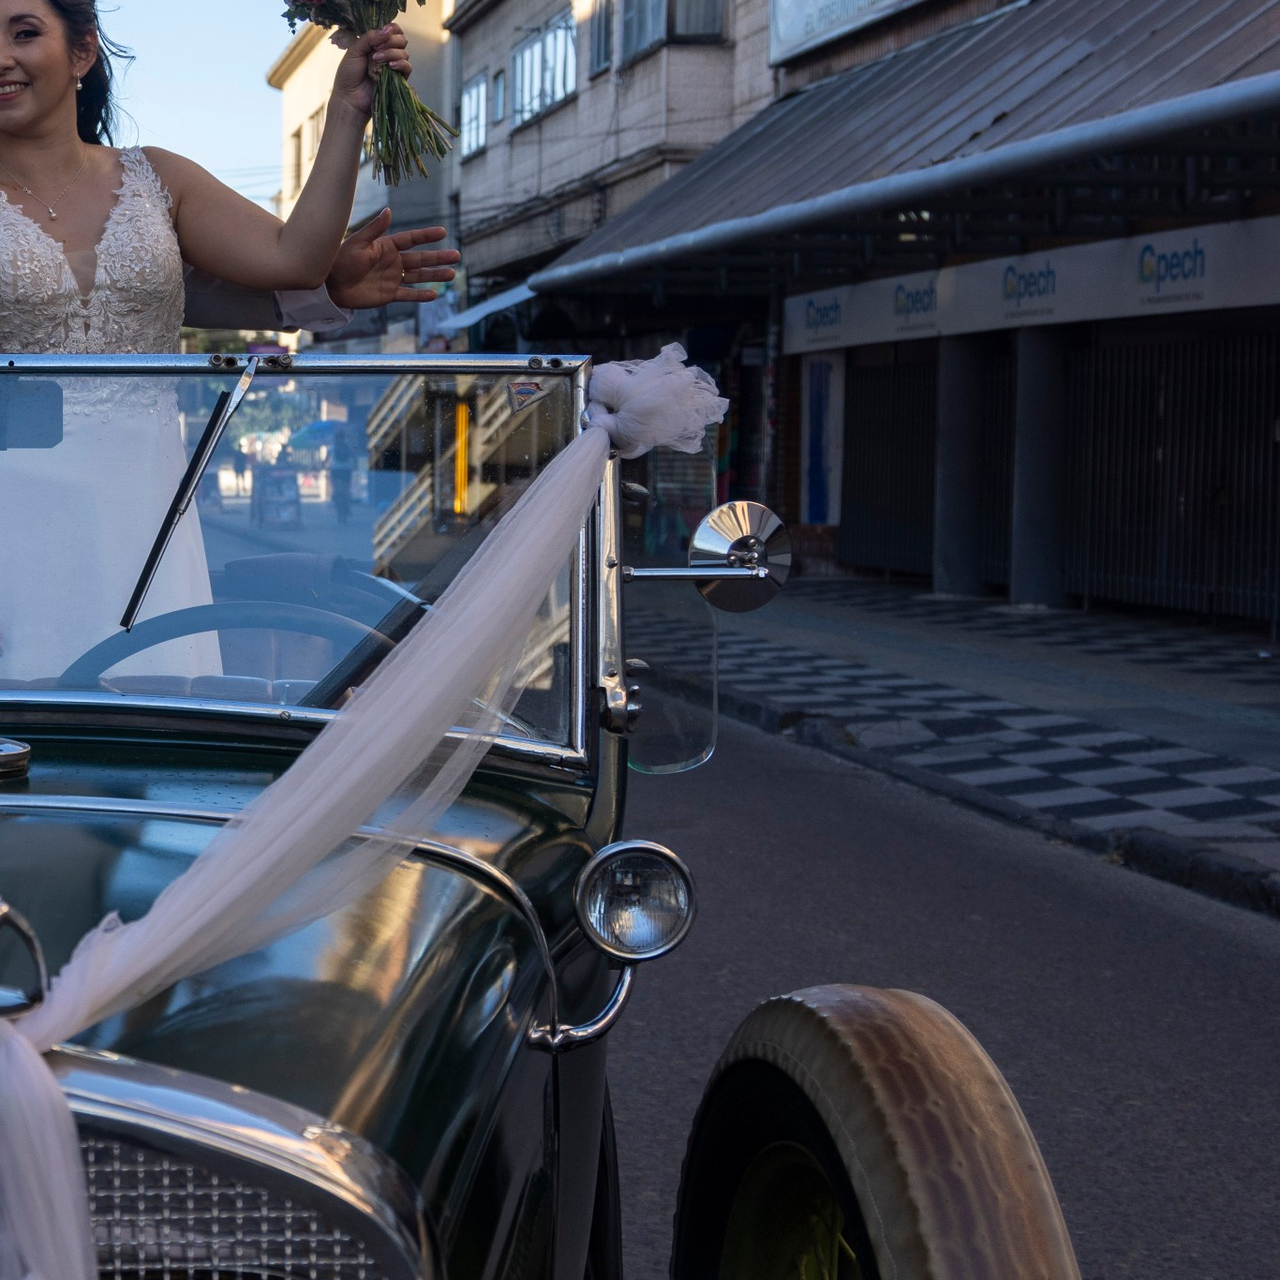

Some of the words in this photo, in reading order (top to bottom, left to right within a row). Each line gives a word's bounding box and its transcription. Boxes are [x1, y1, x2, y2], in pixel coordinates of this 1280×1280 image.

[1002, 259, 1056, 307] Cpech
[1139, 238, 1205, 293] Cpech
[894, 278, 937, 322] Cpech
